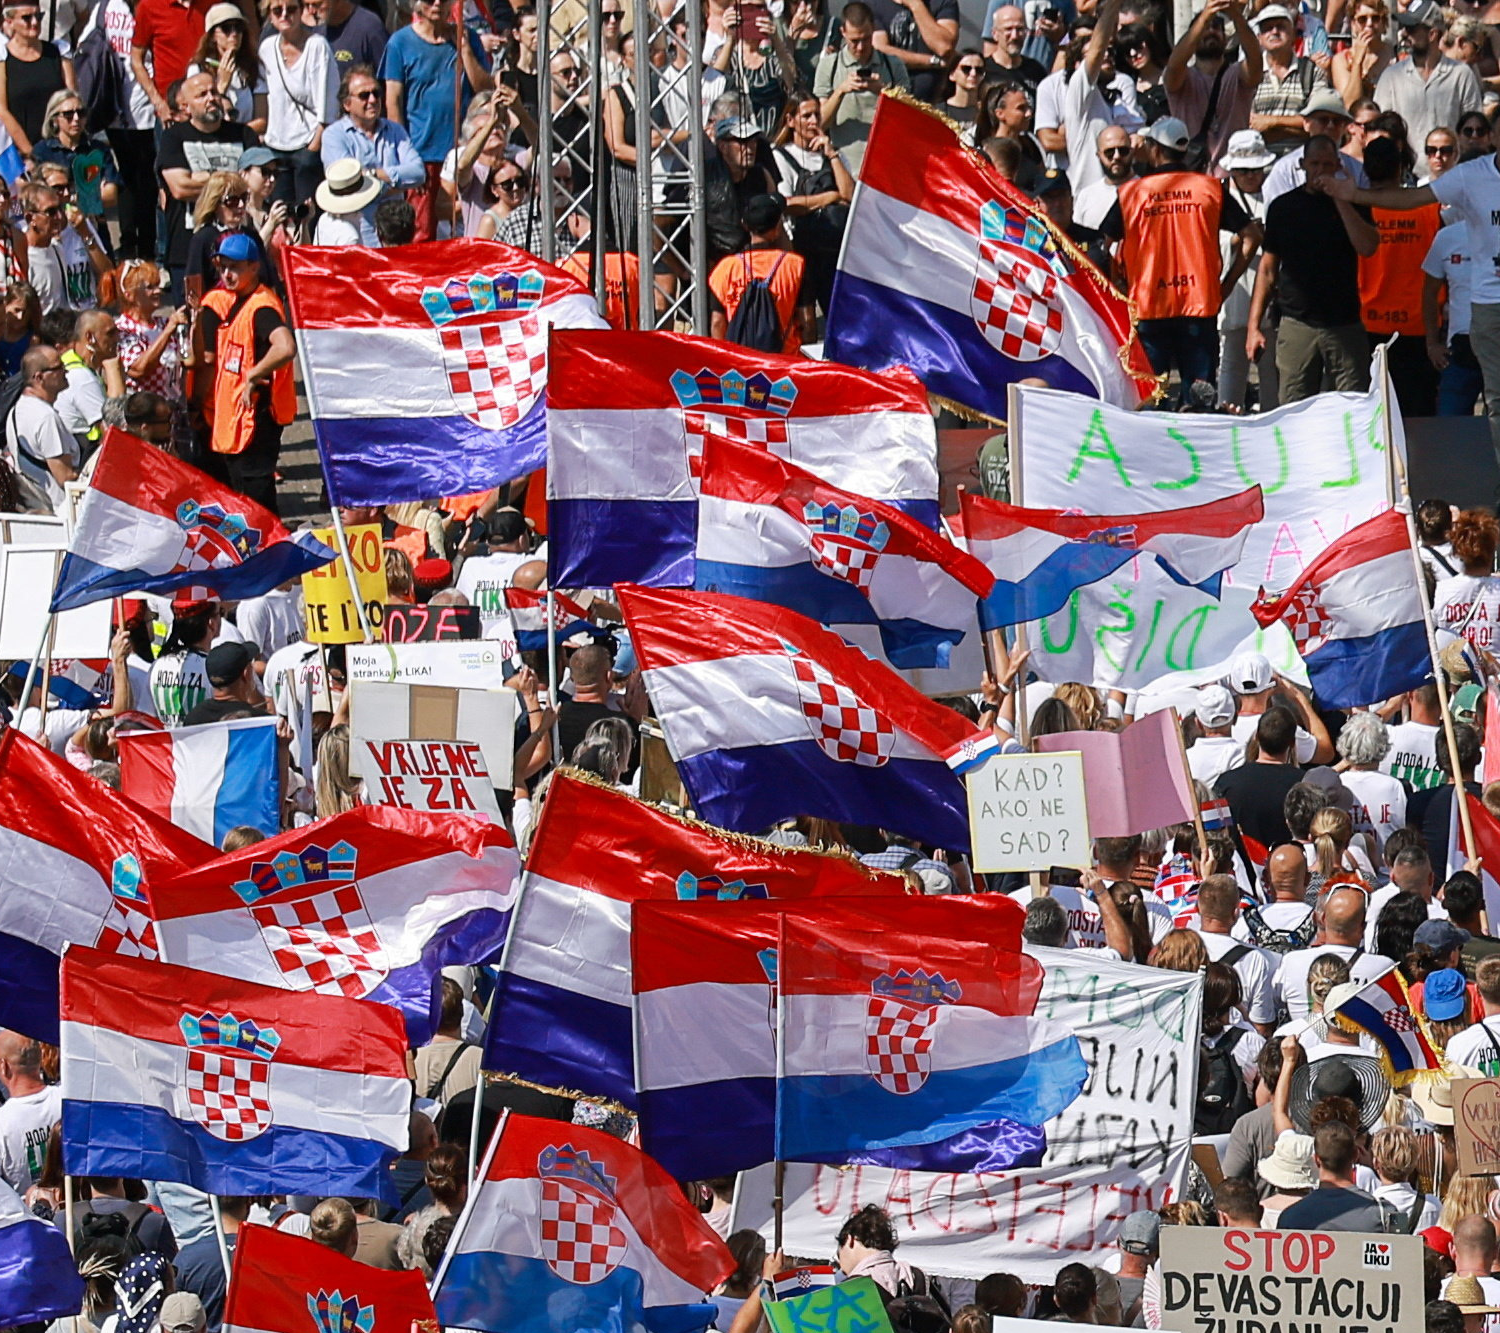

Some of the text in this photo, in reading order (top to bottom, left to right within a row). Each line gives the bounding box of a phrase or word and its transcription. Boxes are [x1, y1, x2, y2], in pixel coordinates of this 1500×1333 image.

[1149, 190, 1193, 202] KLEMM
[1144, 202, 1201, 218] SECURITY
[353, 656, 377, 669] Moja
[353, 667, 390, 679] stranka
[405, 666, 431, 677] LIKA!
[366, 741, 489, 777] VRIJEME
[995, 762, 1064, 793] KAD?
[379, 776, 477, 811] JE ZA
[981, 798, 1065, 821] AKO NE
[1000, 828, 1069, 856] SAD?
[1223, 1230, 1336, 1275] STOP
[1364, 1242, 1378, 1254] JA
[1363, 1254, 1390, 1267] LIKU
[1162, 1270, 1401, 1323] DEVASTACIJI
